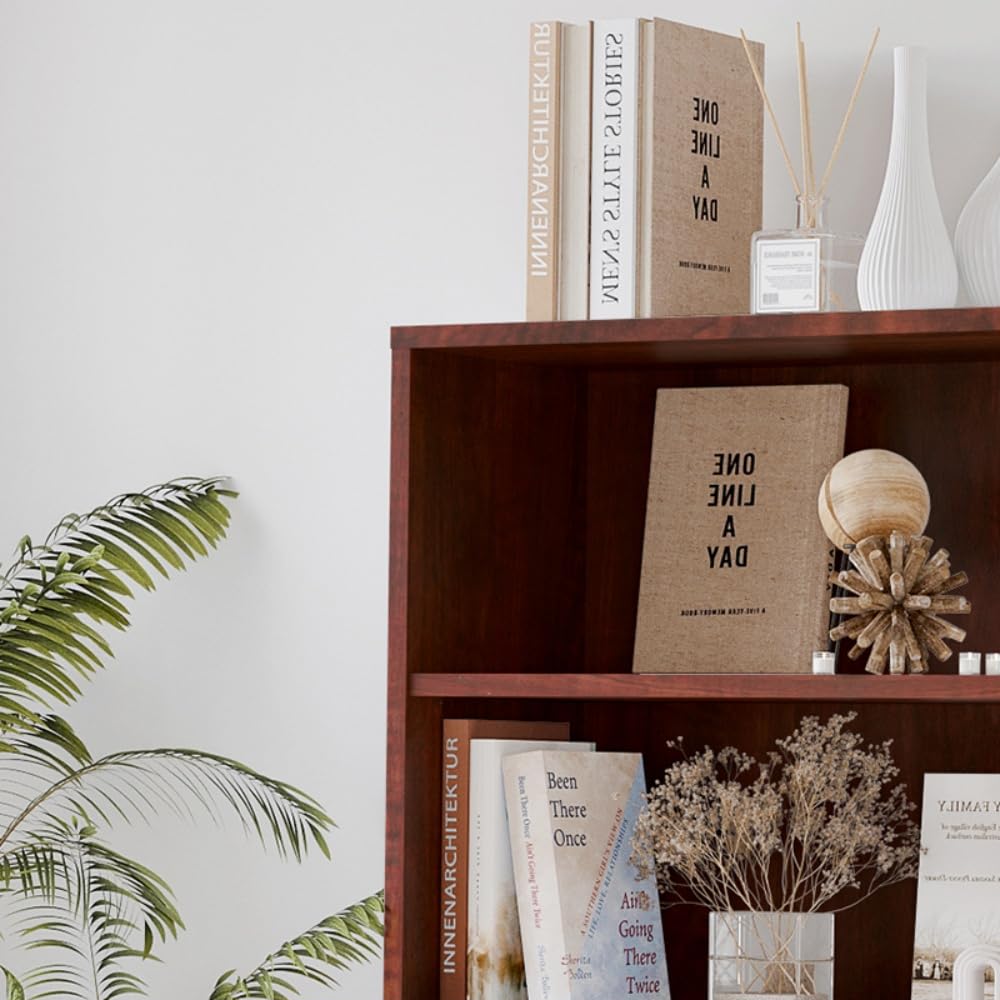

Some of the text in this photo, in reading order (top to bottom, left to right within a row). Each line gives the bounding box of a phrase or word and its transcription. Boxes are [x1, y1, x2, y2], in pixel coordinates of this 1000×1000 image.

[547, 771, 577, 790] Been
[550, 800, 586, 819] There
[553, 829, 587, 847] Once
[444, 737, 459, 974] INNENARCHITEKTUR
[619, 921, 654, 942] Going
[624, 948, 657, 967] There
[626, 975, 660, 994] Twice
